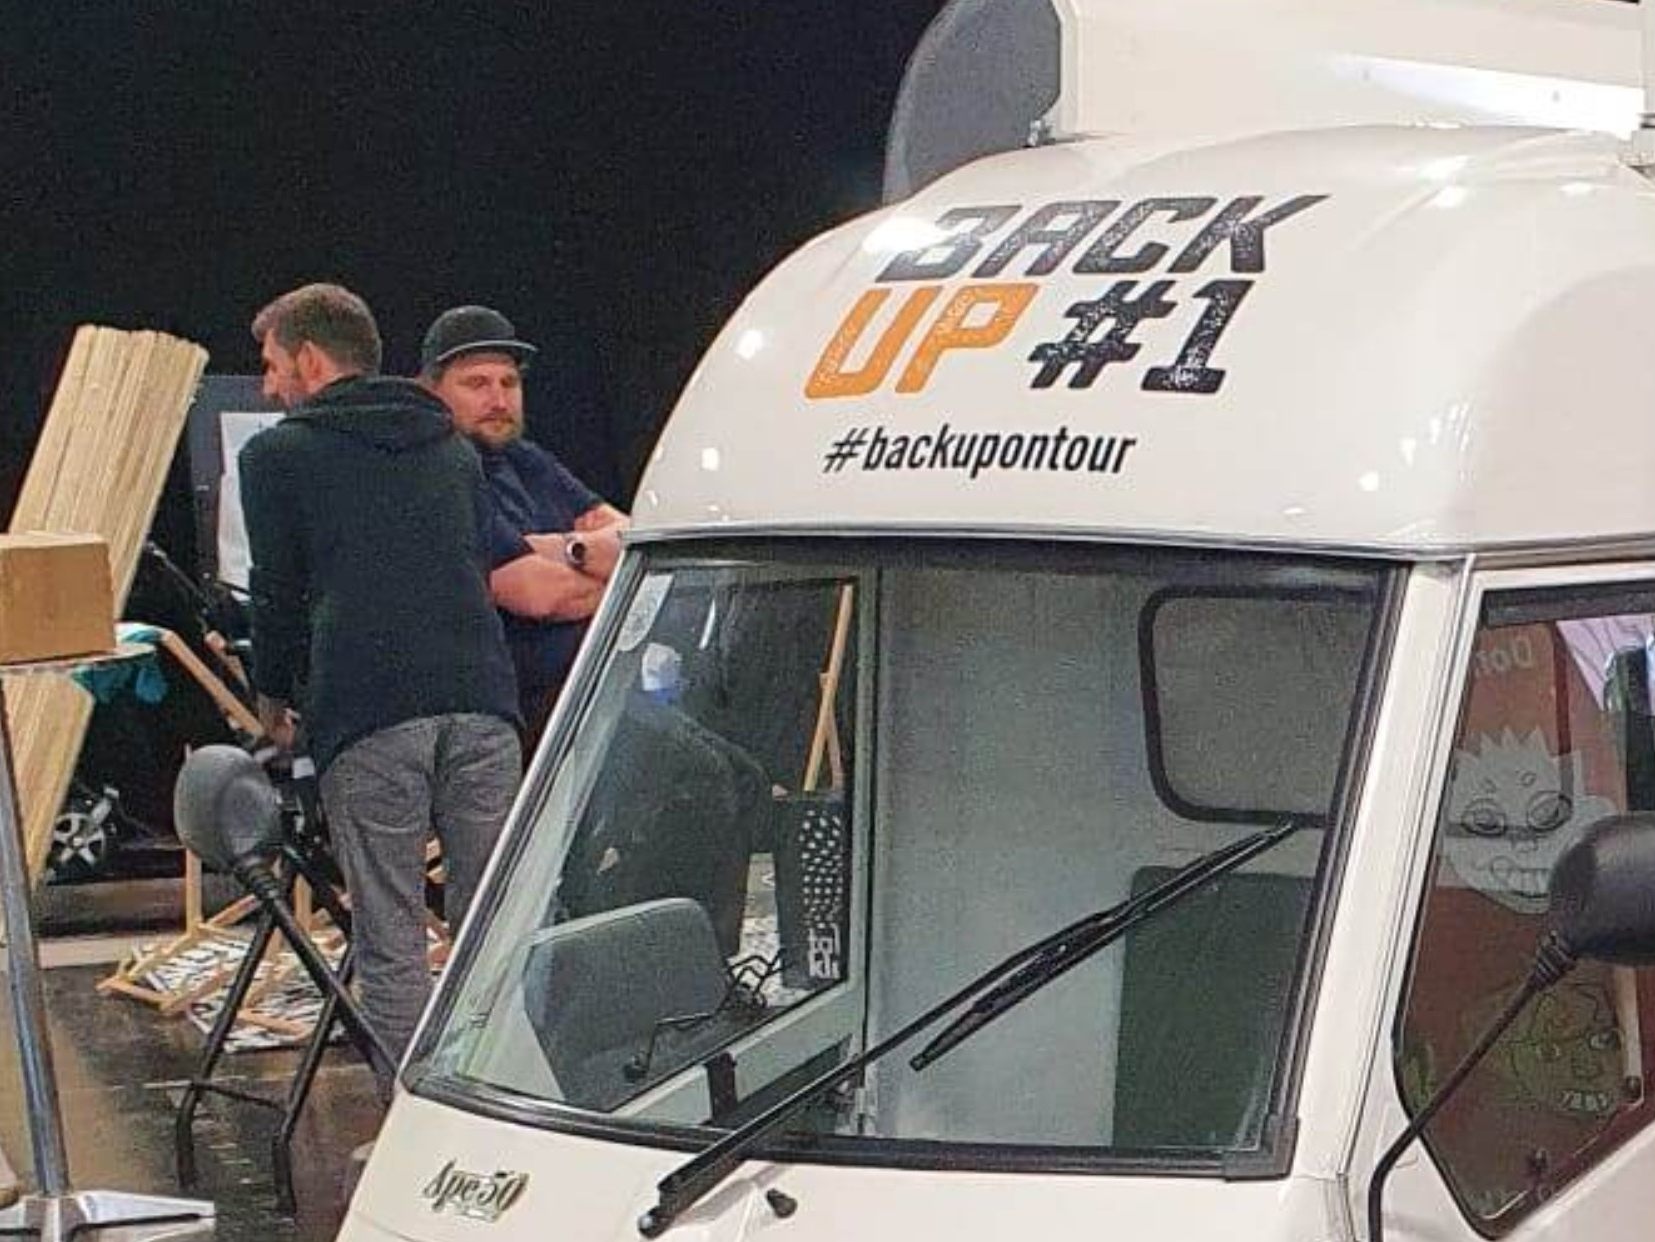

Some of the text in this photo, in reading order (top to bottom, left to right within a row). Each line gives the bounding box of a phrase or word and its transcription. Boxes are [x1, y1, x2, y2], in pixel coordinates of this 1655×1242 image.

[874, 195, 1331, 282] BACK
[803, 278, 1256, 400] UP #1
[822, 423, 1137, 479] #backupontour
